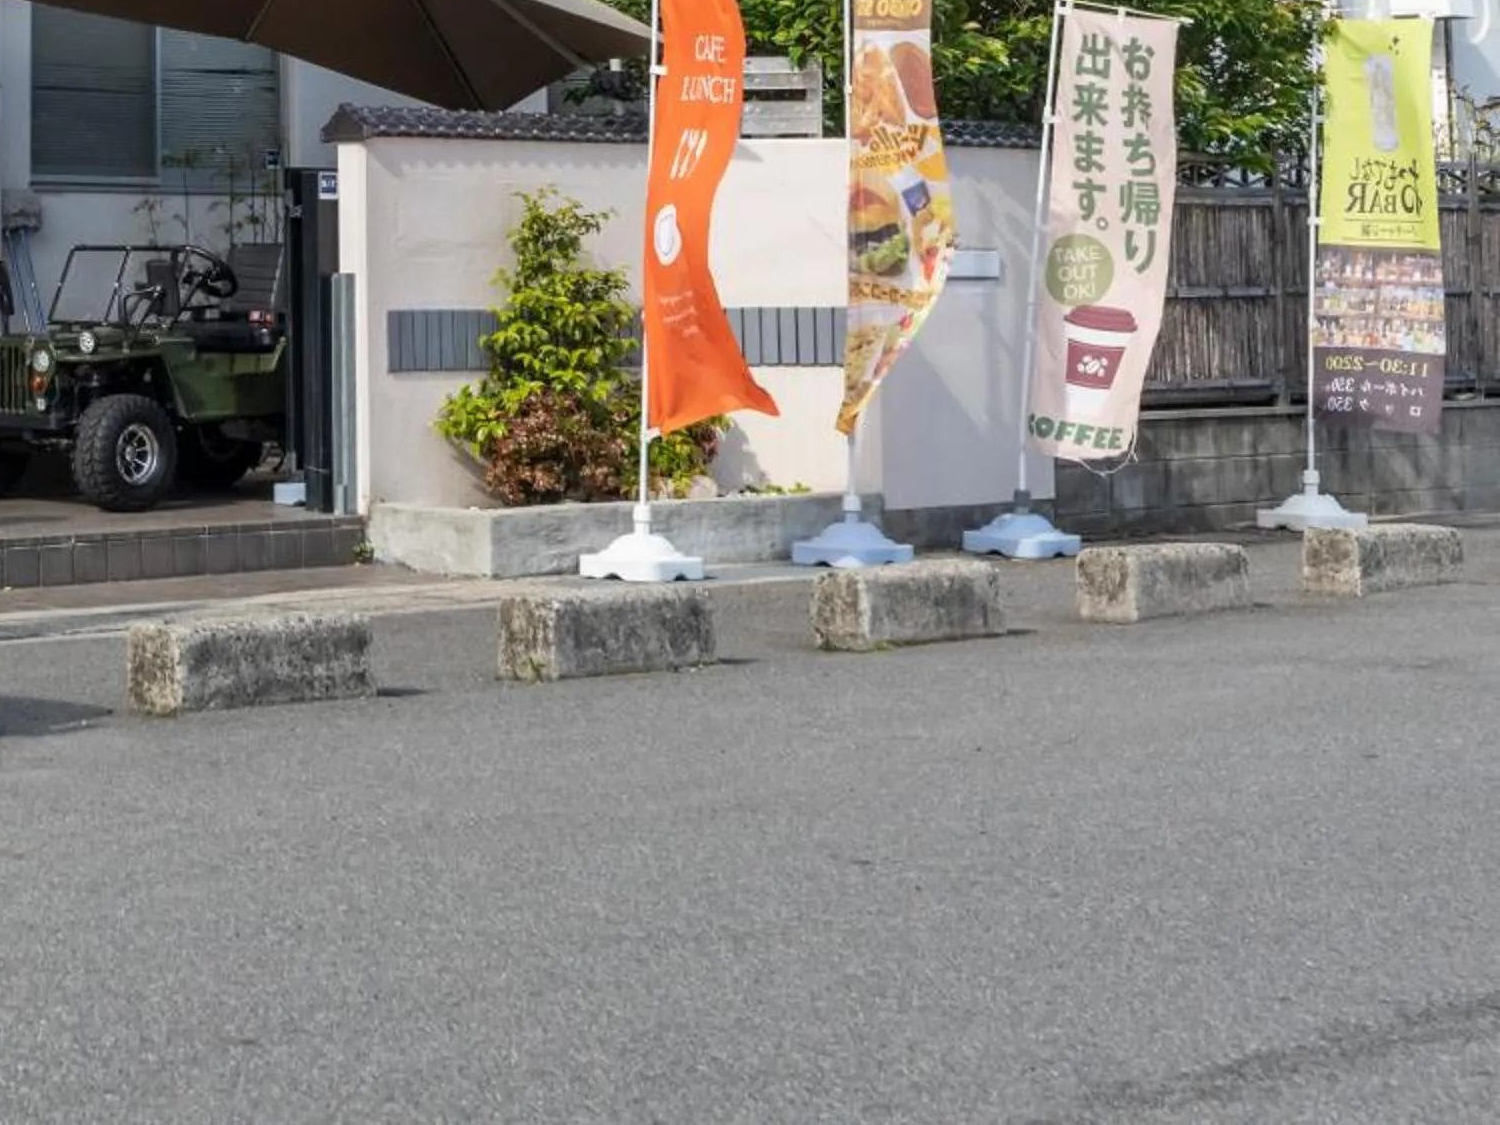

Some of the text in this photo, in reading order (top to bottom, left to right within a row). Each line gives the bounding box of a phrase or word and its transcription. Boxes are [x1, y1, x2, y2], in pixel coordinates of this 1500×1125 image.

[694, 34, 727, 64] CAFE
[680, 75, 737, 104] LUNCH
[1071, 32, 1112, 231] 出来ます。
[1120, 35, 1163, 275] お持ち帰り
[1054, 245, 1103, 264] TAKE
[1057, 264, 1098, 282] OUT
